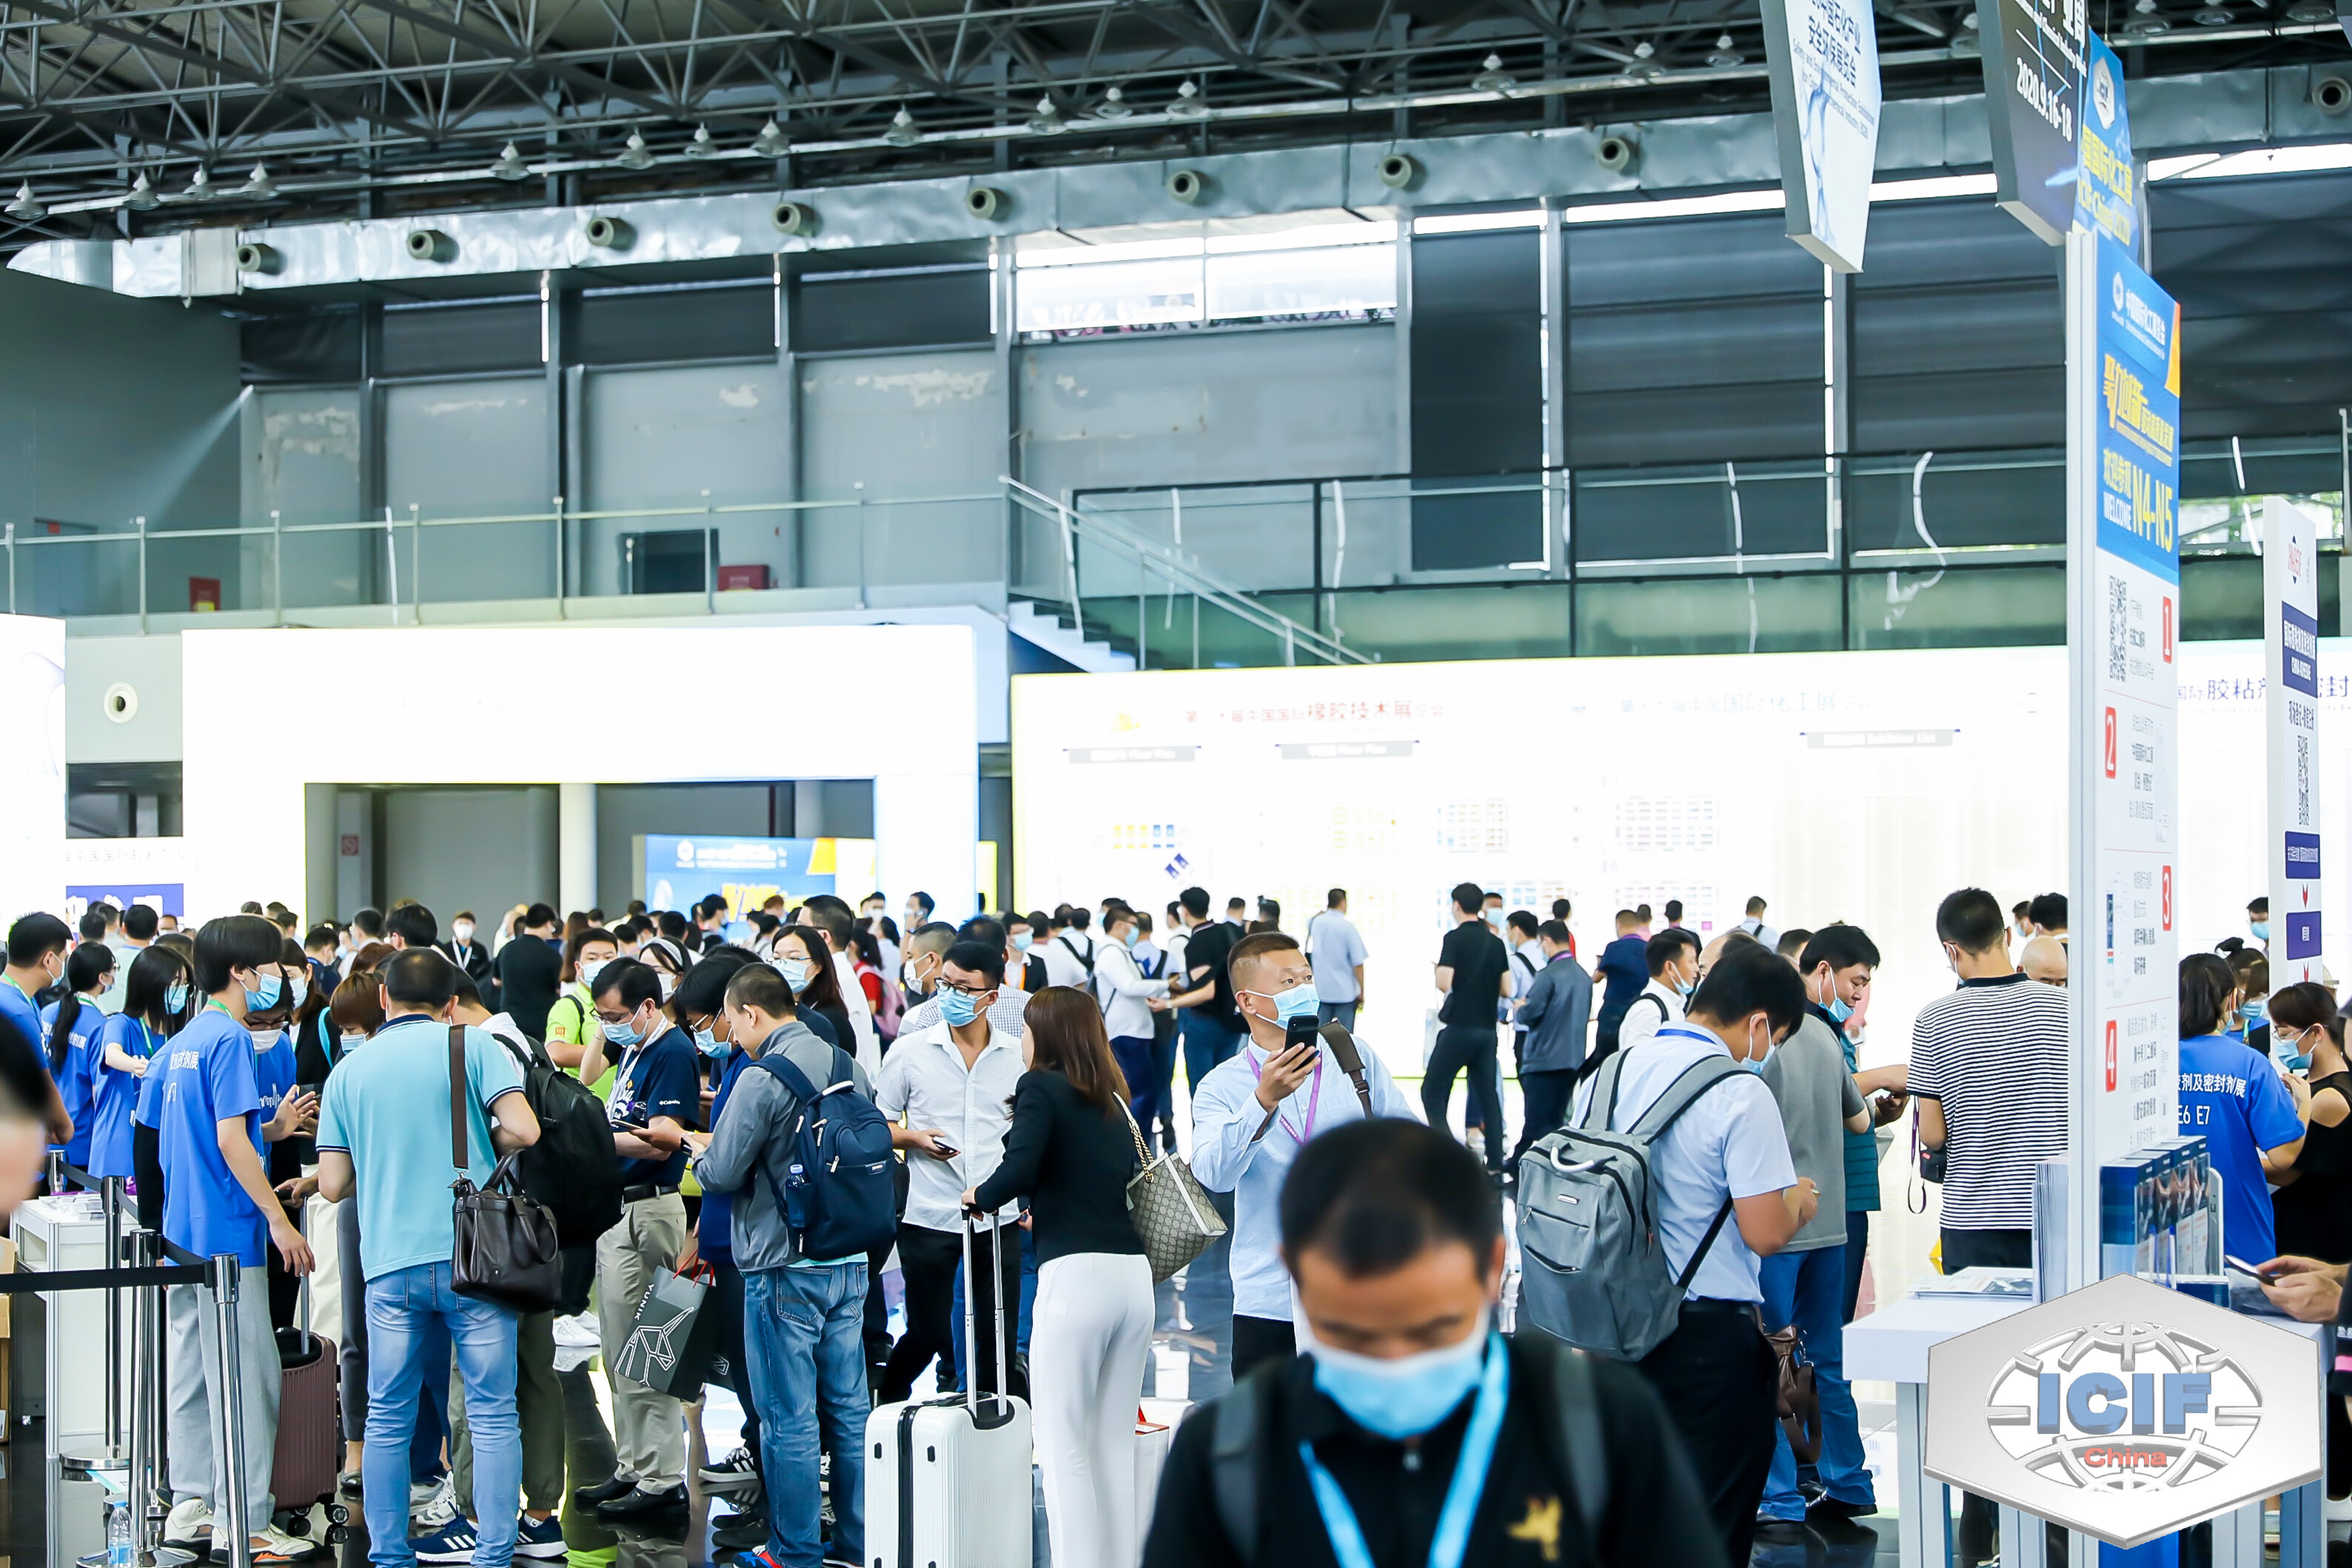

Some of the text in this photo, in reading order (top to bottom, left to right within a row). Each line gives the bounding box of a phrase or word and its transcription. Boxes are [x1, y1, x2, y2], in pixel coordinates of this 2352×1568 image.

[2017, 57, 2072, 142] 2020.9.16-18
[2103, 465, 2173, 554] WELCOME N4-N5
[2318, 675, 2349, 697] 封
[2197, 1105, 2211, 1125] E7
[634, 1284, 655, 1321] YUNIK
